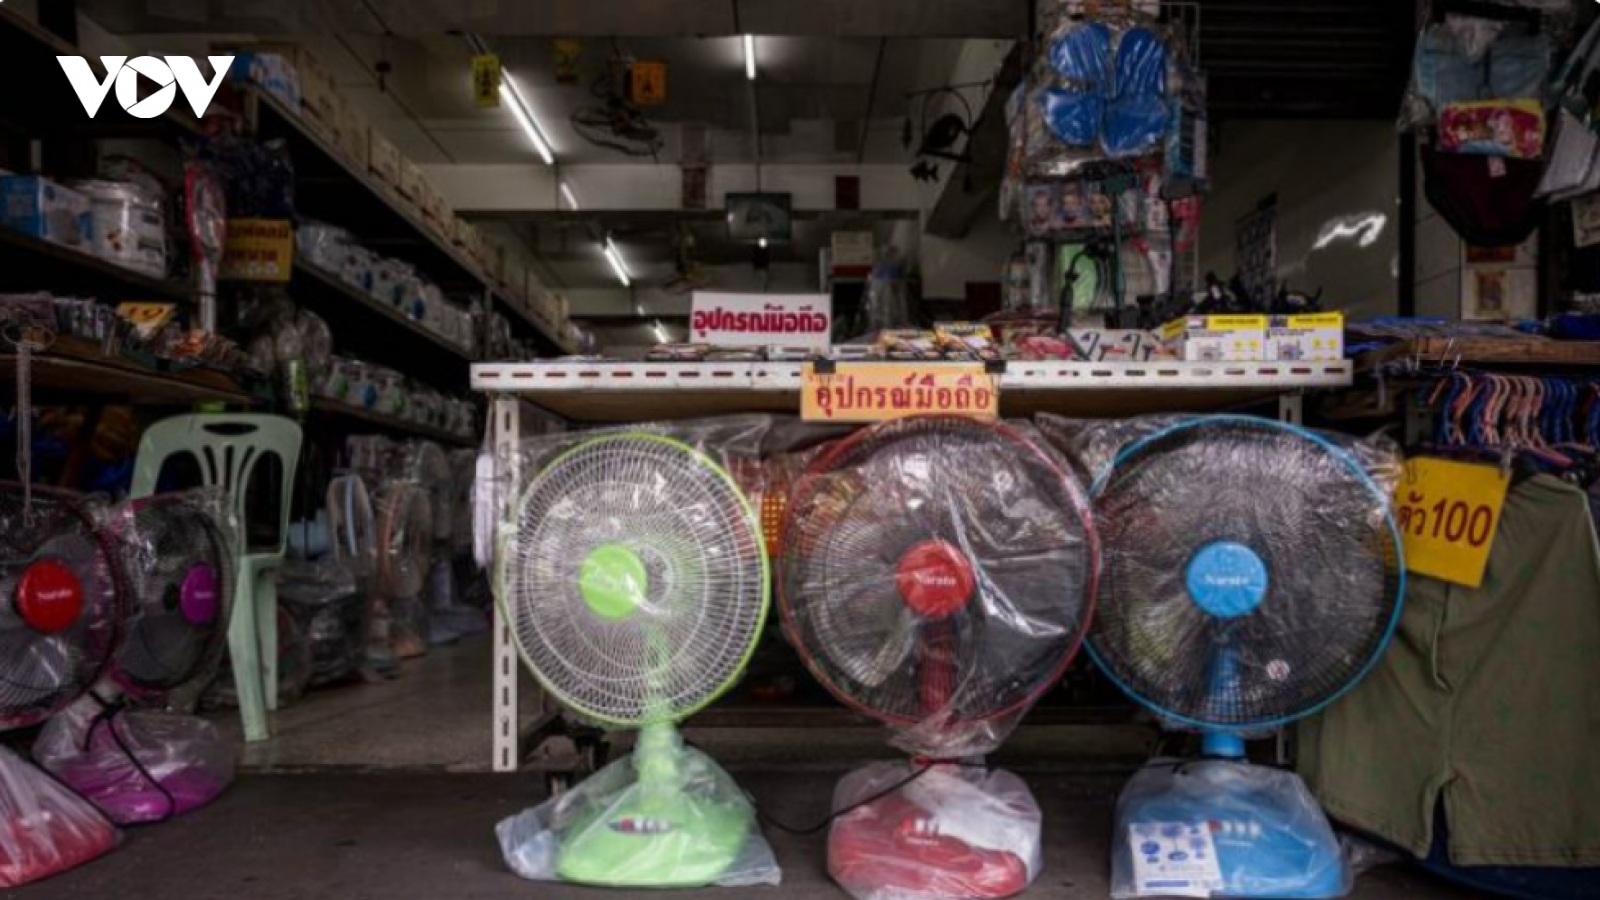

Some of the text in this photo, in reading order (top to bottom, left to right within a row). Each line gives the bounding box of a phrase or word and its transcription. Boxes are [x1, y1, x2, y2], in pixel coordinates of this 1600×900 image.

[693, 302, 828, 338] อุปกรณ์มือถือ
[815, 372, 991, 418] อุปกรณ์มือถือ
[1431, 497, 1493, 549] 100
